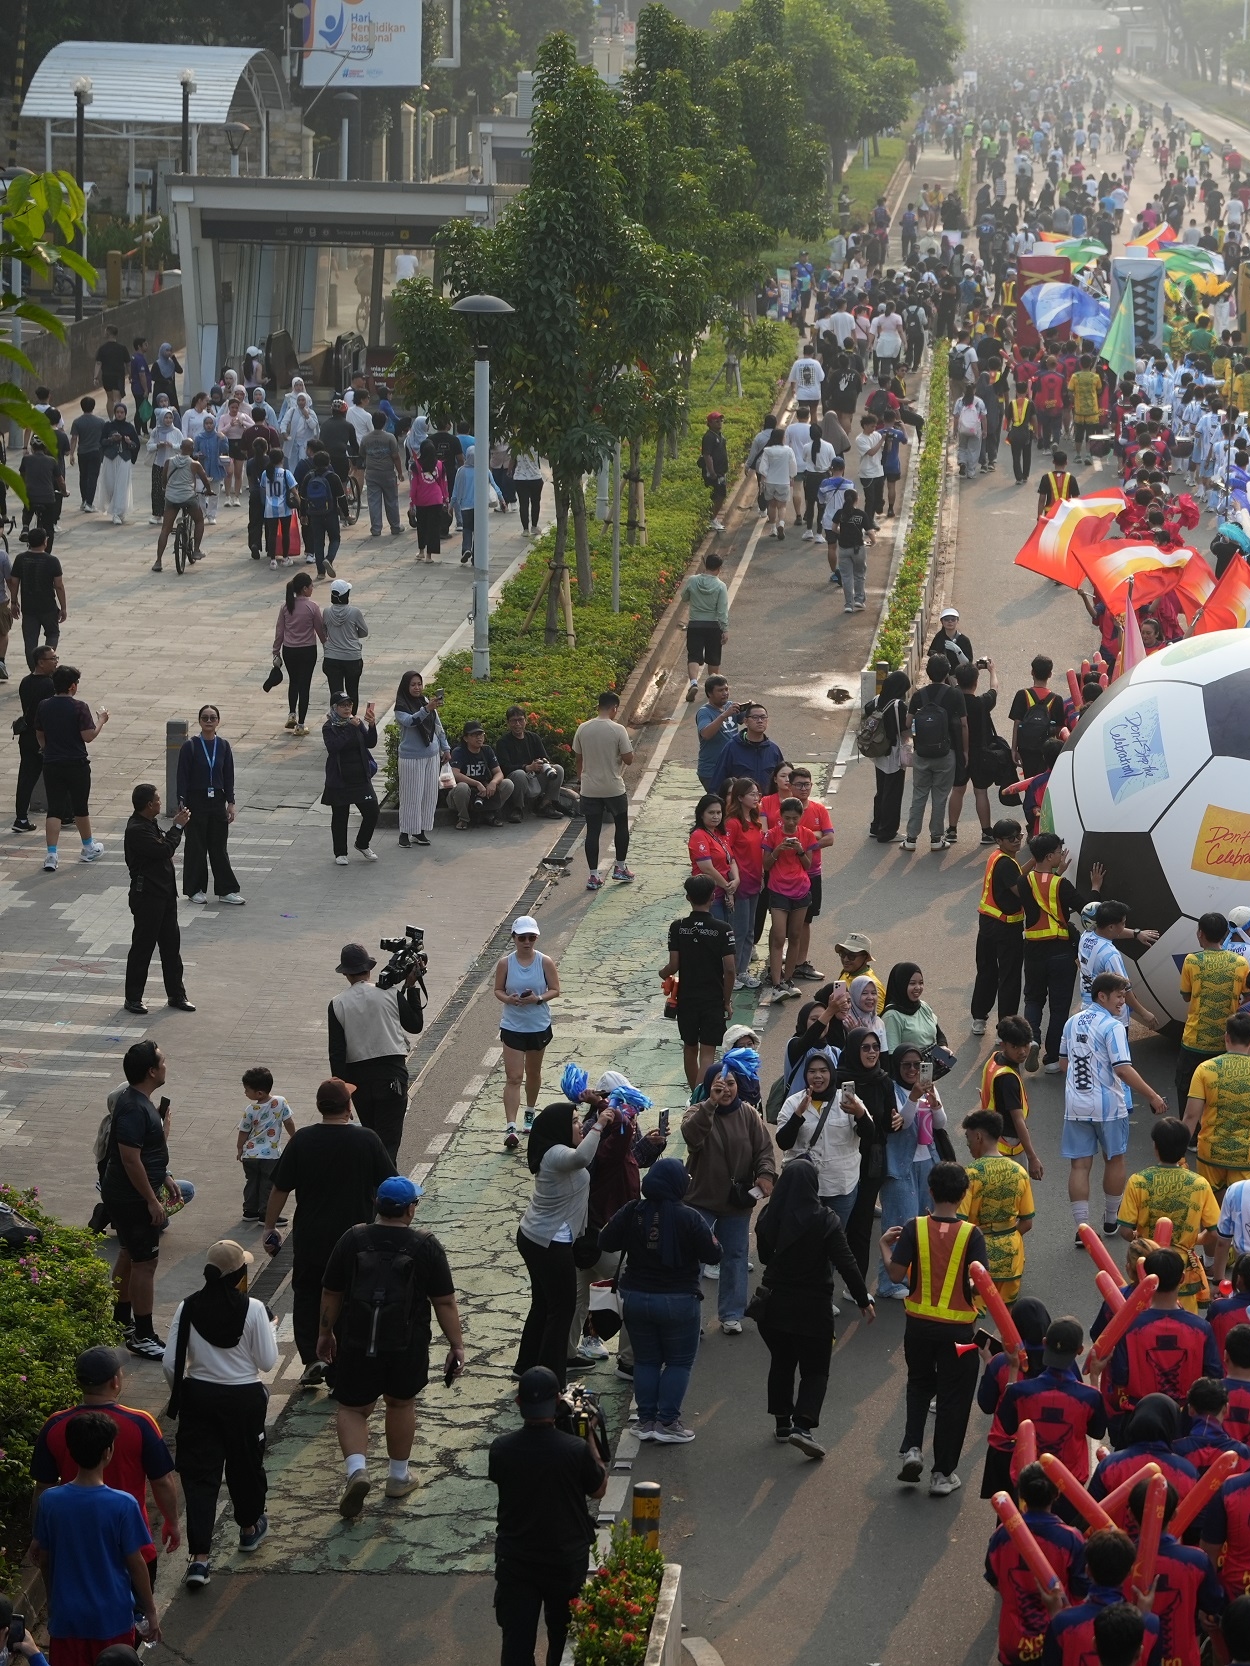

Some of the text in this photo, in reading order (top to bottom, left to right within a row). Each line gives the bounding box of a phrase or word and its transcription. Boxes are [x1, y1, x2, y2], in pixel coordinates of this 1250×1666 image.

[351, 12, 371, 22] Hari
[351, 23, 406, 33] Penidikan
[351, 33, 392, 43] Nasonal
[269, 481, 281, 498] 10
[466, 764, 486, 776] 1527
[1153, 1173, 1186, 1187] Hydro
